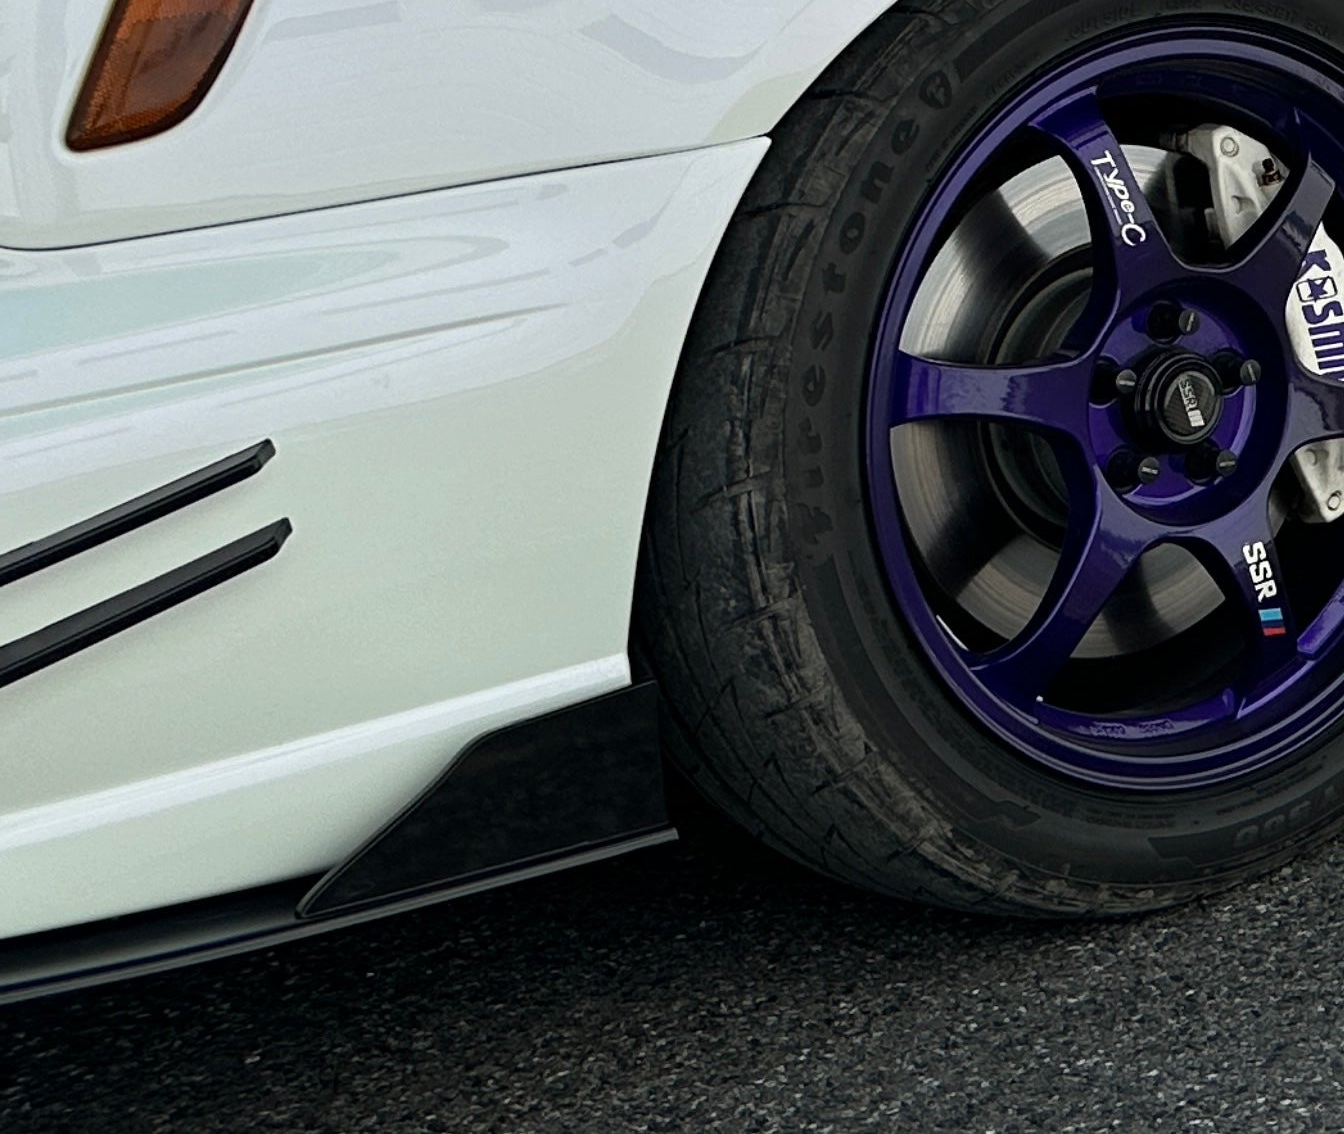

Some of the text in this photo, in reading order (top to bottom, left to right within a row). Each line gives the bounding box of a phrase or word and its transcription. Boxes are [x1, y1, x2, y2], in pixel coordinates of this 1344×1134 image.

[1090, 149, 1147, 246] Type-C
[796, 116, 920, 546] Firestone
[1242, 541, 1278, 603] SSR
